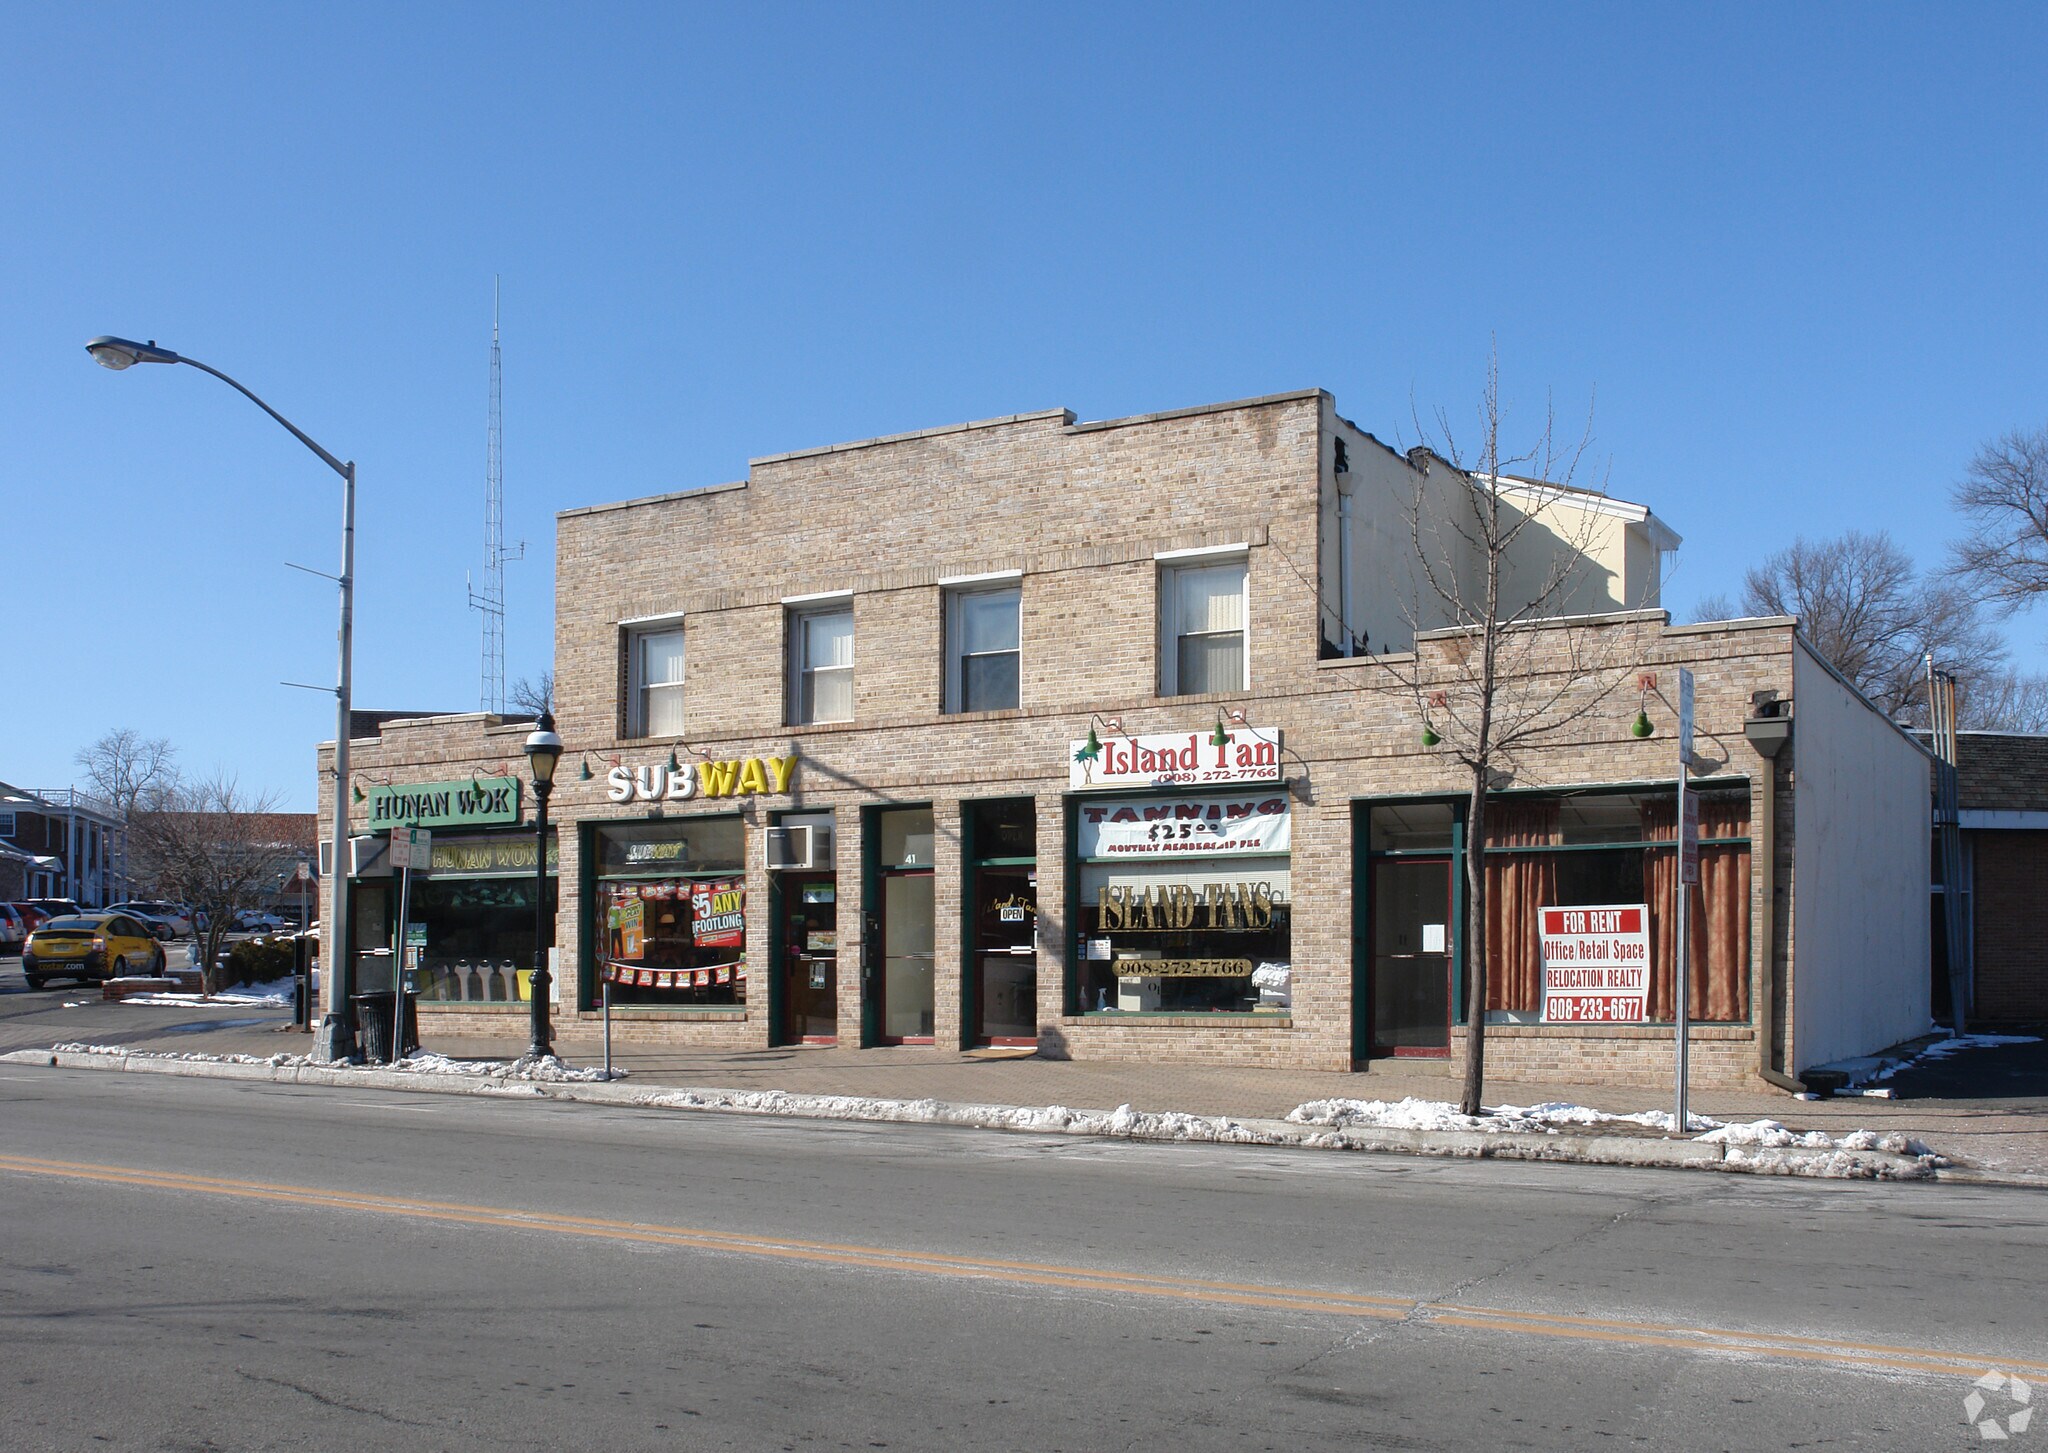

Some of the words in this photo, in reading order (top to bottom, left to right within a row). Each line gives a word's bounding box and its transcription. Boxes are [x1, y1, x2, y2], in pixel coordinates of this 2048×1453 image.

[1103, 734, 1199, 775] Island
[1208, 733, 1277, 768] Tan
[607, 756, 799, 802] SUBWAY
[1157, 772, 1197, 784] (908)
[1202, 767, 1277, 780] 272-7766
[374, 791, 450, 821] HUNAN
[455, 787, 510, 815] WOK
[1084, 799, 1287, 823] TANNING
[432, 845, 492, 869] HUNAN
[496, 843, 538, 866] WOK
[1107, 843, 1160, 853] MONTHLY
[1240, 839, 1261, 848] FEE
[905, 854, 916, 864] 41
[692, 892, 711, 918] $5
[712, 890, 742, 915] ANY
[1002, 908, 1023, 919] OPEN
[1097, 884, 1195, 930] ISLAND
[1203, 881, 1272, 929] TANS
[695, 913, 742, 933] FOOTLONG
[1563, 911, 1586, 933] FOR
[1590, 911, 1621, 933] RENT
[1544, 939, 1609, 961] Office/Retail
[1613, 939, 1645, 962] Space
[1120, 961, 1245, 975] 908-272-7766
[1547, 969, 1604, 987] RELOCATION
[1607, 969, 1643, 987] REALTY
[1549, 997, 1640, 1020] 908-233-6677
